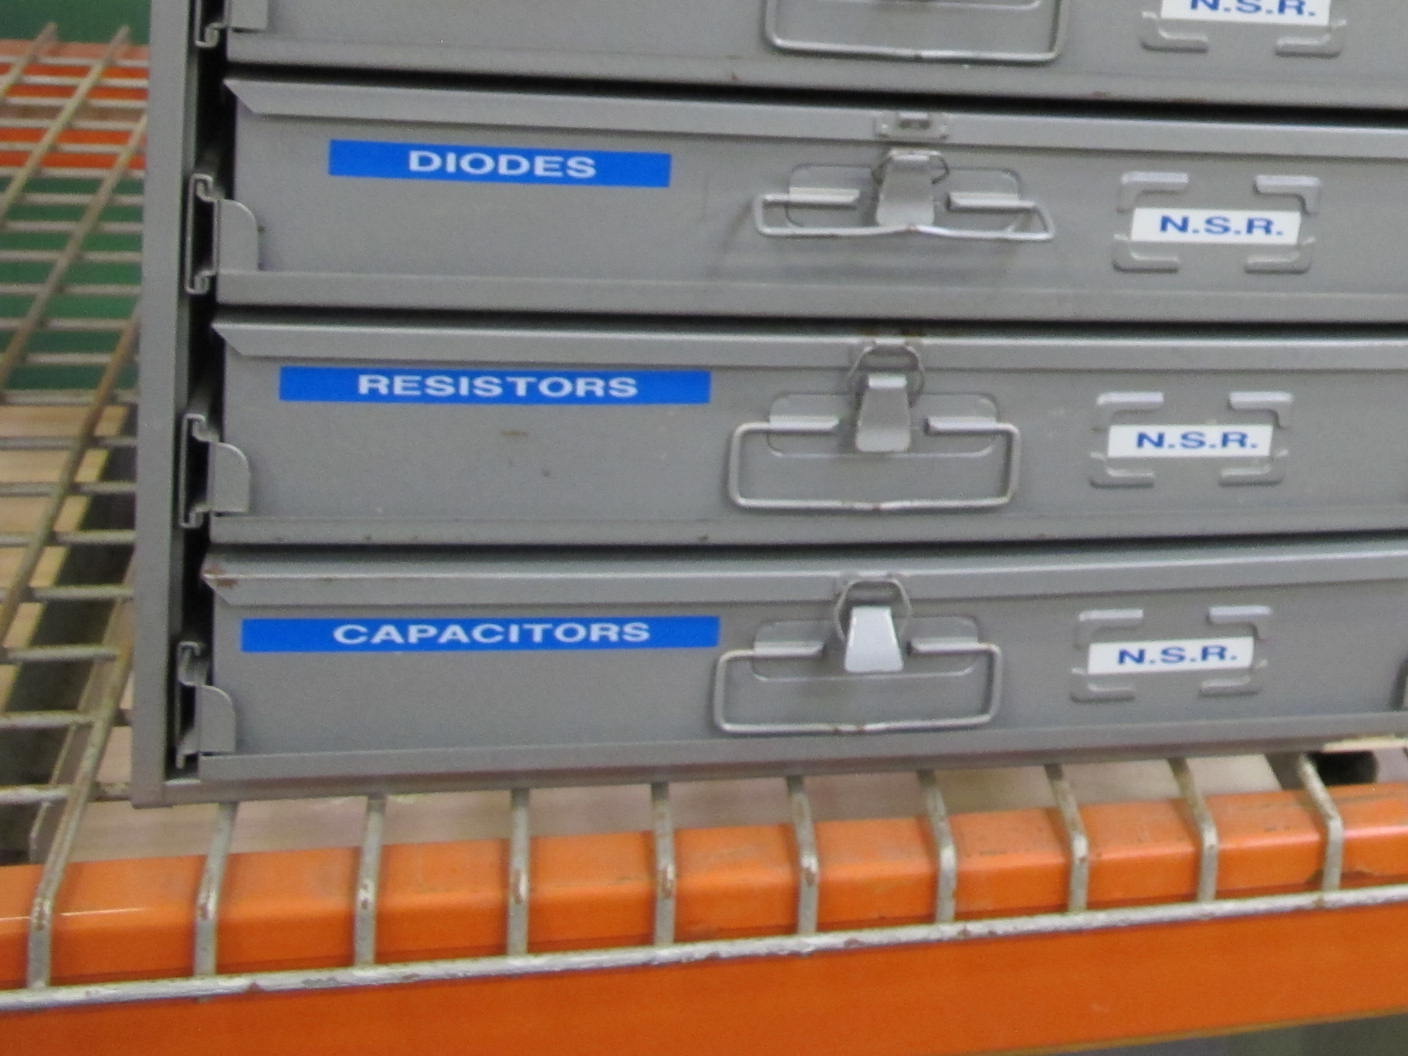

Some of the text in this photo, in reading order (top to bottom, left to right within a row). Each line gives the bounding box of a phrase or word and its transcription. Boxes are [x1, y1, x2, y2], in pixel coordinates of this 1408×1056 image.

[408, 149, 597, 179] DIODES
[1159, 214, 1285, 237] N.S.R.
[357, 373, 639, 399] RESISTORS
[1136, 430, 1259, 450] N.S.R.
[332, 622, 651, 645] CAPACITORS
[1117, 644, 1239, 666] N.S.R.
